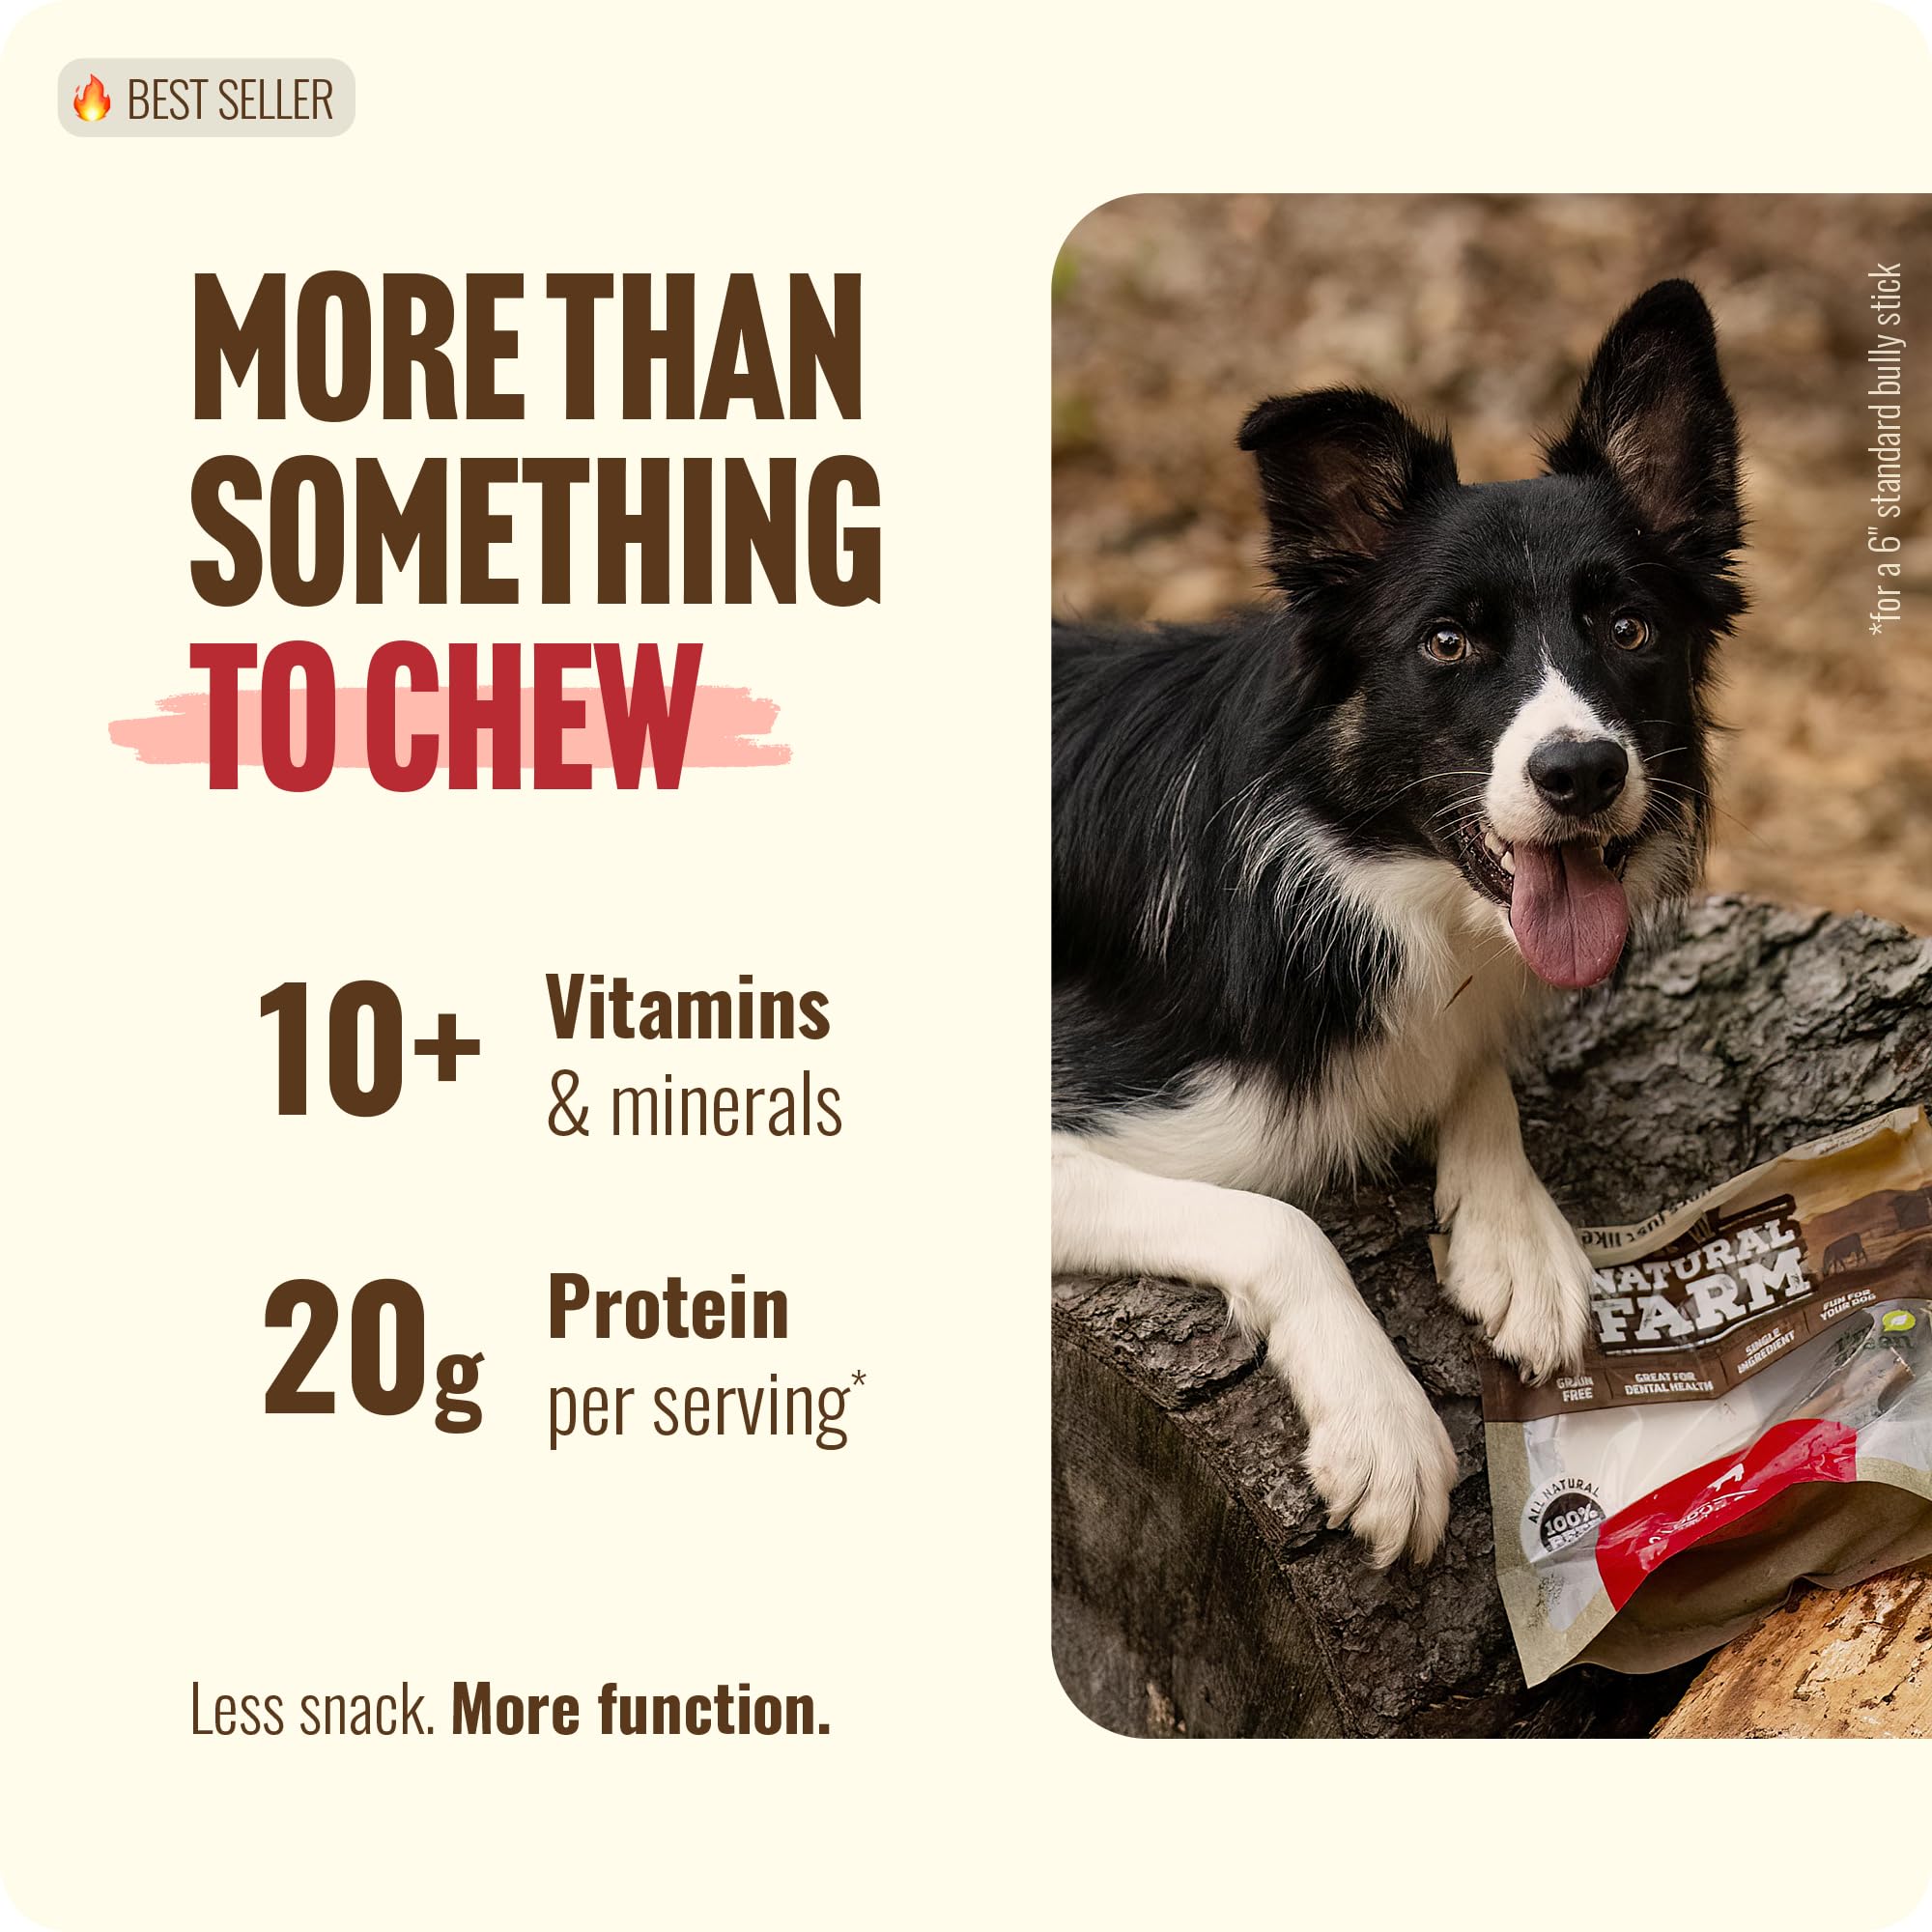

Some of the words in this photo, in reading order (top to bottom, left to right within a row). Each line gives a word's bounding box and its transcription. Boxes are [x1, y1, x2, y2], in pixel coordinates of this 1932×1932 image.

[1580, 1230, 1622, 1249] like
[1591, 1219, 1796, 1294] NATURAL
[1590, 1246, 1811, 1344] FARM
[1820, 1300, 1852, 1321] YOUR
[1851, 1293, 1877, 1308] DOG
[1823, 1294, 1846, 1311] FUN
[1847, 1289, 1871, 1300] FOR
[1737, 1329, 1796, 1375] INGREDIENT
[1746, 1327, 1782, 1355] SINGLE
[1556, 1376, 1594, 1389] GRAIN
[1624, 1382, 1669, 1396] DENTAL
[1669, 1380, 1714, 1393] HEALTH
[1634, 1372, 1671, 1383] GREAT
[1672, 1372, 1697, 1382] FOR
[1562, 1387, 1593, 1403] FREE
[1528, 1501, 1546, 1524] ALL
[1542, 1478, 1600, 1500] NATURAL
[1545, 1498, 1599, 1537] 100%
